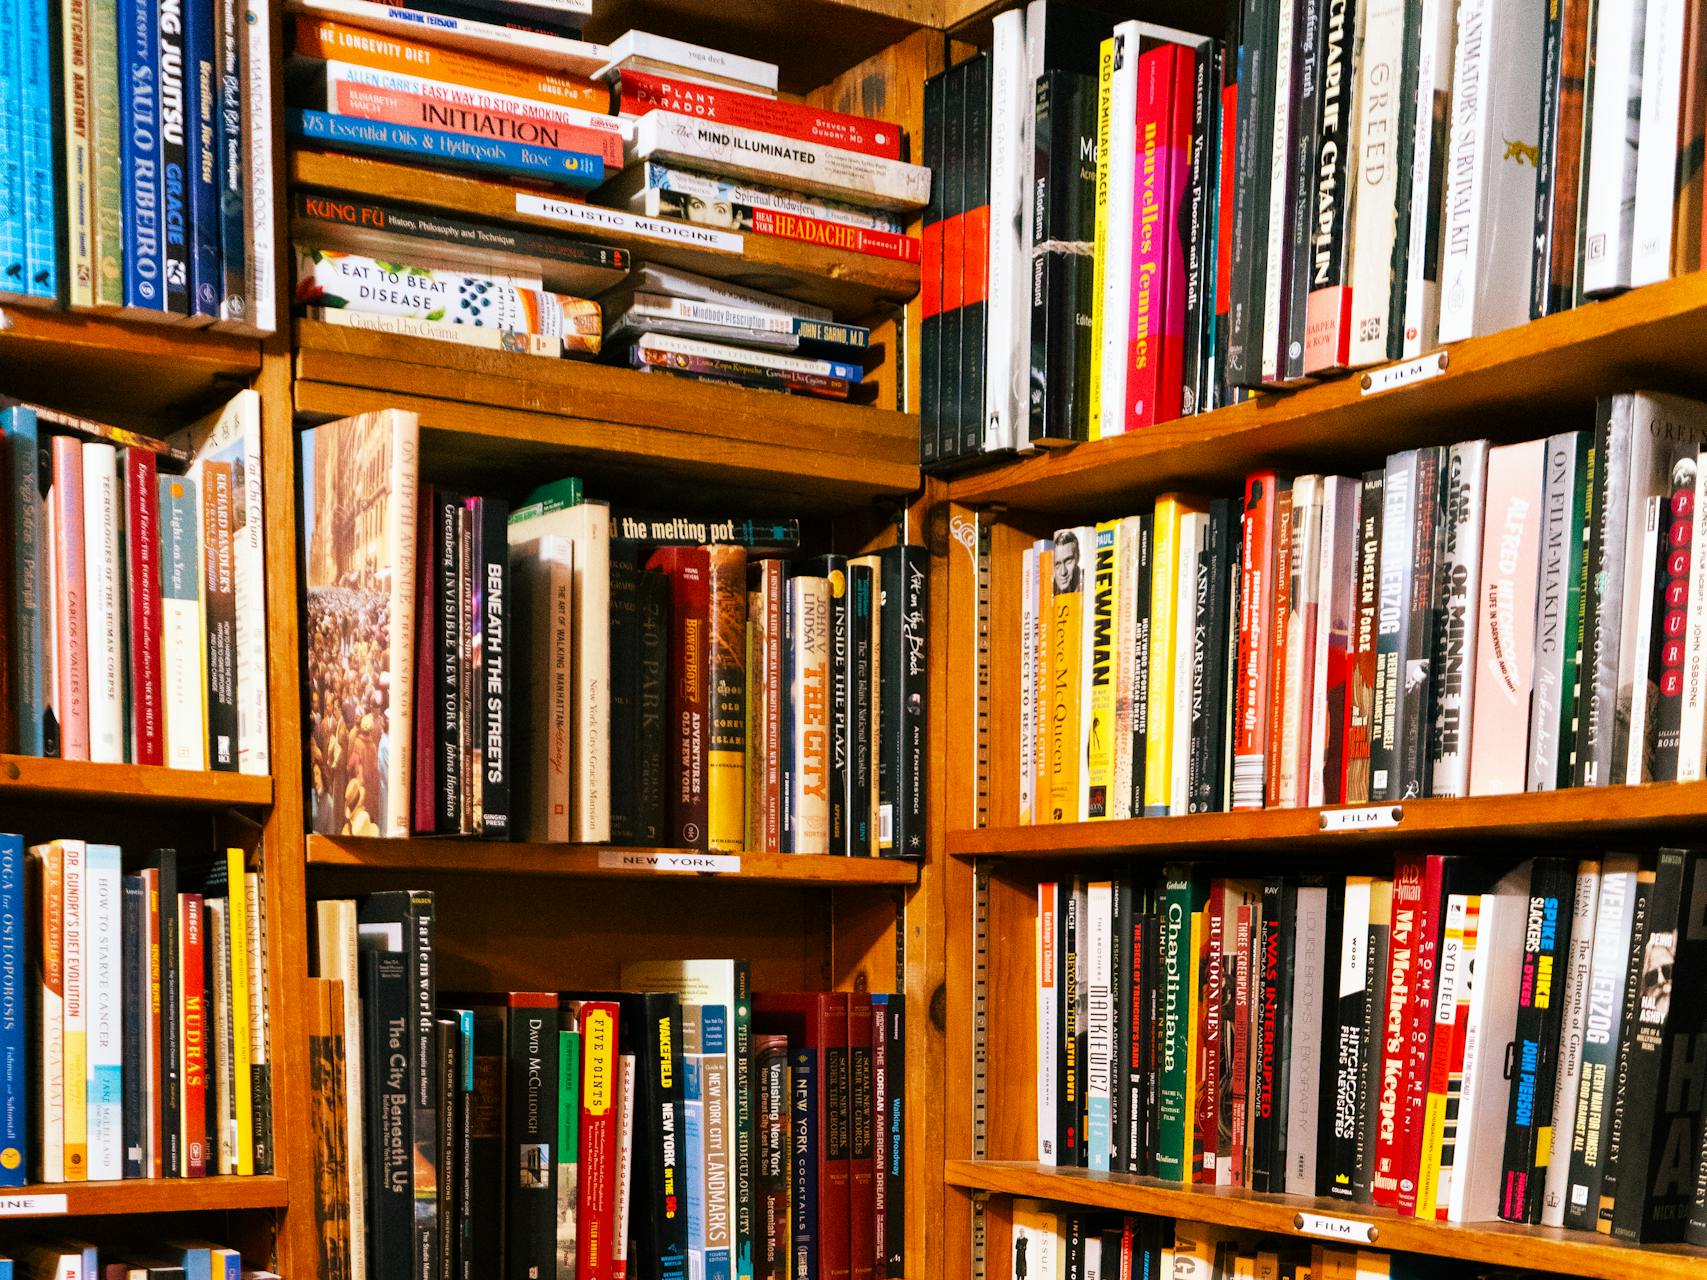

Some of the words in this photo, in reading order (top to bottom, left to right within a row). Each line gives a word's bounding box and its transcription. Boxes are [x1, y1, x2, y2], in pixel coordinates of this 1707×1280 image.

[338, 31, 401, 59] LONGEVITY
[405, 48, 431, 64] DIET
[1102, 54, 1111, 81] OLD
[132, 63, 153, 152] SAULO
[346, 69, 381, 88] ALLEN
[382, 77, 420, 93] CARR'S
[422, 86, 449, 101] EASY
[451, 92, 476, 106] WAY
[477, 95, 491, 108] TO
[494, 98, 520, 113] STOP
[522, 104, 570, 124] SMOKING
[637, 89, 716, 117] PARADOX
[662, 83, 714, 106] PLANT
[421, 102, 559, 147] INITIATION
[698, 129, 730, 146] MIND
[733, 136, 816, 165] ILLUMINATED
[1100, 87, 1111, 159] FAMILIAR
[1365, 64, 1389, 186] GREED
[166, 163, 183, 245] GRACIE
[1098, 162, 1108, 207] FACES
[1138, 122, 1157, 253] nouvelles
[135, 156, 156, 279] RIBEIRO
[305, 198, 356, 223] KUNG
[388, 215, 416, 231] History,
[418, 220, 459, 237] Philosophy
[461, 228, 476, 238] and
[477, 231, 515, 245] Technique
[542, 203, 625, 226] HOLISTIC
[635, 220, 718, 243] MEDICINE
[774, 214, 856, 249] HEADACHE
[1314, 138, 1338, 285] CHAPLIN
[342, 263, 369, 279] EAT
[378, 271, 399, 284] TO
[407, 276, 447, 293] BEAT
[360, 286, 432, 309] DISEASE
[1136, 259, 1156, 369] femmes
[1384, 366, 1422, 382] FILM
[623, 518, 647, 539] the
[652, 519, 707, 543] melting
[711, 521, 734, 544] pot
[1365, 516, 1374, 539] THE
[1198, 563, 1208, 619] ANNA
[1361, 540, 1378, 604] UNSEEN
[487, 563, 502, 652] BENEATH
[1092, 549, 1113, 686] NEWMAN
[1358, 607, 1375, 653] FORCE
[835, 606, 846, 666] INSIDE
[1058, 606, 1070, 665] Steve
[489, 656, 502, 693] THE
[836, 674, 846, 706] THE
[1192, 624, 1206, 722] KARENINA
[488, 697, 502, 783] STREETS
[835, 713, 846, 769] PLAZA
[1053, 668, 1069, 775] McQueen
[1342, 813, 1378, 822] FILM
[624, 856, 658, 864] NEW
[669, 857, 715, 868] YORK
[1392, 910, 1413, 944] My
[1542, 897, 1558, 951] SPIKE
[419, 916, 430, 1033] harlemworld:
[1209, 916, 1221, 1000] BUFFOON
[1535, 956, 1553, 1008] MIKE
[1164, 903, 1181, 1073] Chapliniana
[1387, 947, 1410, 1054] Mother's
[186, 997, 200, 1087] MUDRAS
[529, 1018, 541, 1054] DAVID
[594, 1019, 605, 1050] FIVE
[1208, 1004, 1219, 1040] MEN
[658, 1018, 671, 1088] WAKEFIELD
[592, 1057, 603, 1107] POINTS
[708, 1073, 720, 1096] NEW
[770, 1064, 780, 1121] Vanishing
[1381, 1057, 1402, 1145] Keeper
[708, 1099, 720, 1124] YORK
[771, 1125, 779, 1146] New
[708, 1127, 721, 1149] CITY
[771, 1149, 779, 1175] York
[708, 1153, 726, 1240] LANDMARKS
[1315, 1221, 1350, 1232] FILM
